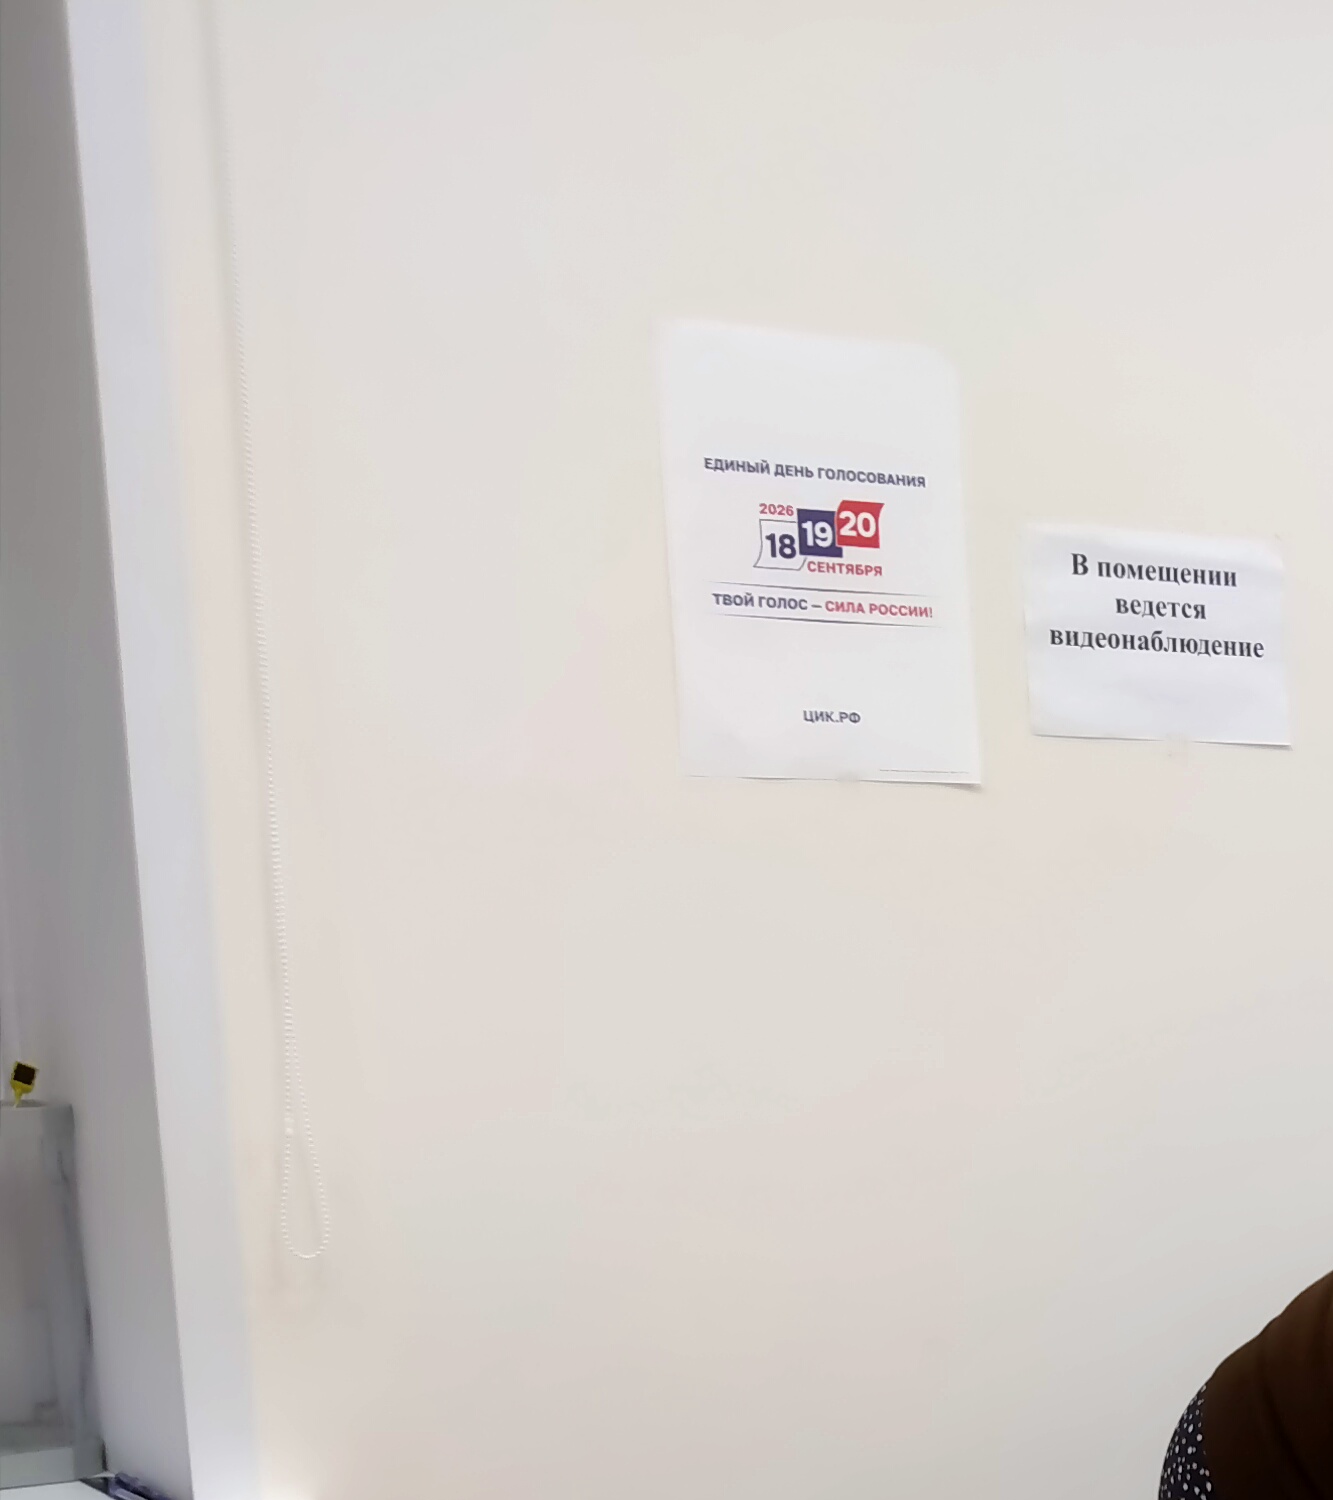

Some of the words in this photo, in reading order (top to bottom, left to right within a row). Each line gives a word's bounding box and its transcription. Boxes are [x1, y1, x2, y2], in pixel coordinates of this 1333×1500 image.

[704, 457, 771, 475] ЕДИНЫЙ
[774, 463, 814, 479] ДЕНЬ
[817, 467, 926, 488] ГОЛОСОВАНИЯ
[758, 503, 795, 517] 2026
[765, 533, 797, 559] 18
[801, 520, 834, 548] 19
[838, 510, 877, 538] 20
[806, 560, 883, 577] СЕНТЯБРЯ
[1071, 552, 1089, 576] В
[1097, 560, 1238, 588] помещении
[711, 592, 755, 607] ТВОЙ
[758, 596, 808, 611] ГОЛОС
[825, 600, 865, 614] СИЛА
[868, 603, 933, 618] РОССИИ!
[1115, 598, 1207, 620] ведется
[1049, 628, 1265, 658] видеонаблюдение
[803, 709, 861, 724] ЦИК.РФ
